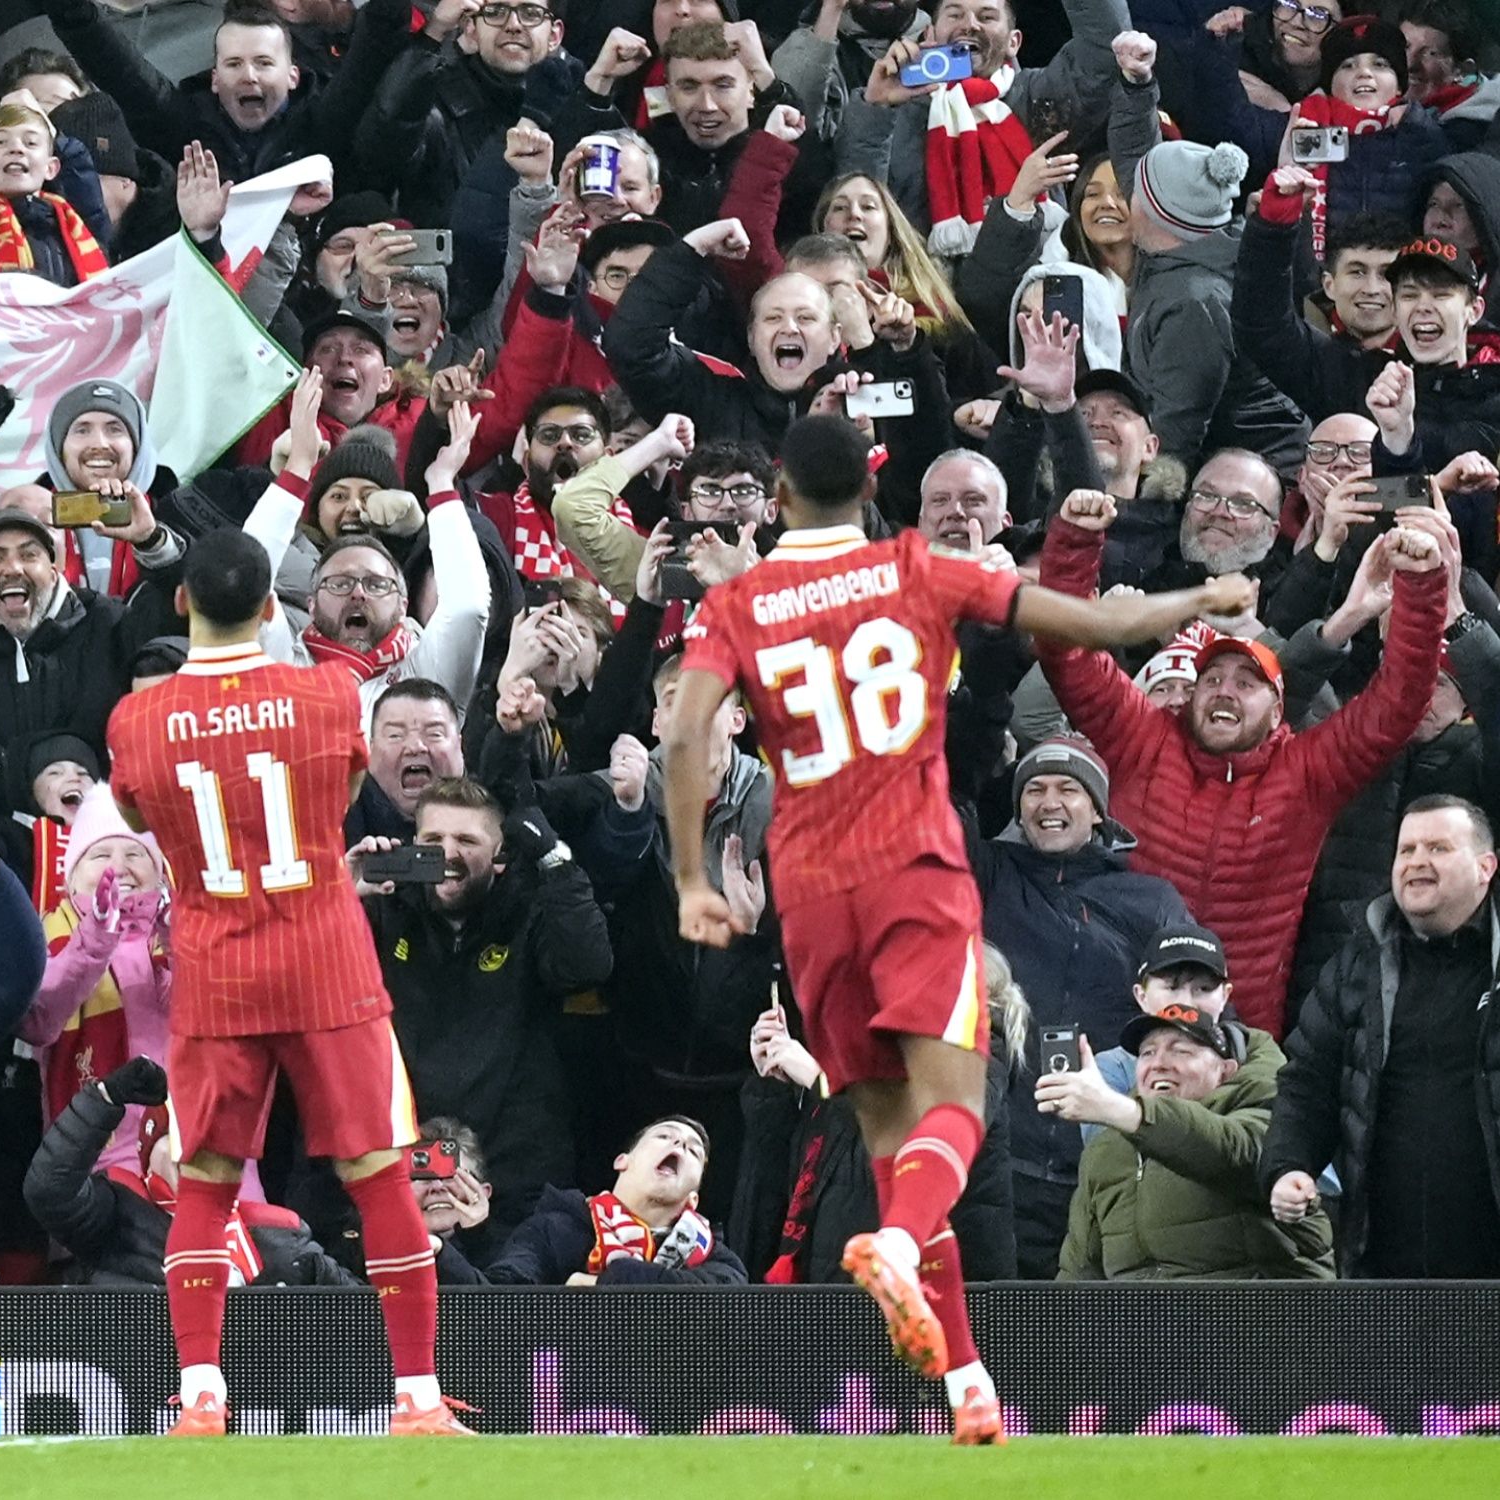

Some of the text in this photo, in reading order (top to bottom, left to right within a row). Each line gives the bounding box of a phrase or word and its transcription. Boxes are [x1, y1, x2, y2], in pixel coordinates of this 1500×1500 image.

[752, 561, 900, 626] GRAVENBERCH
[167, 697, 296, 743] M.SALAH
[755, 616, 930, 789] 38
[175, 751, 313, 898] 11
[183, 1277, 213, 1289] LFC
